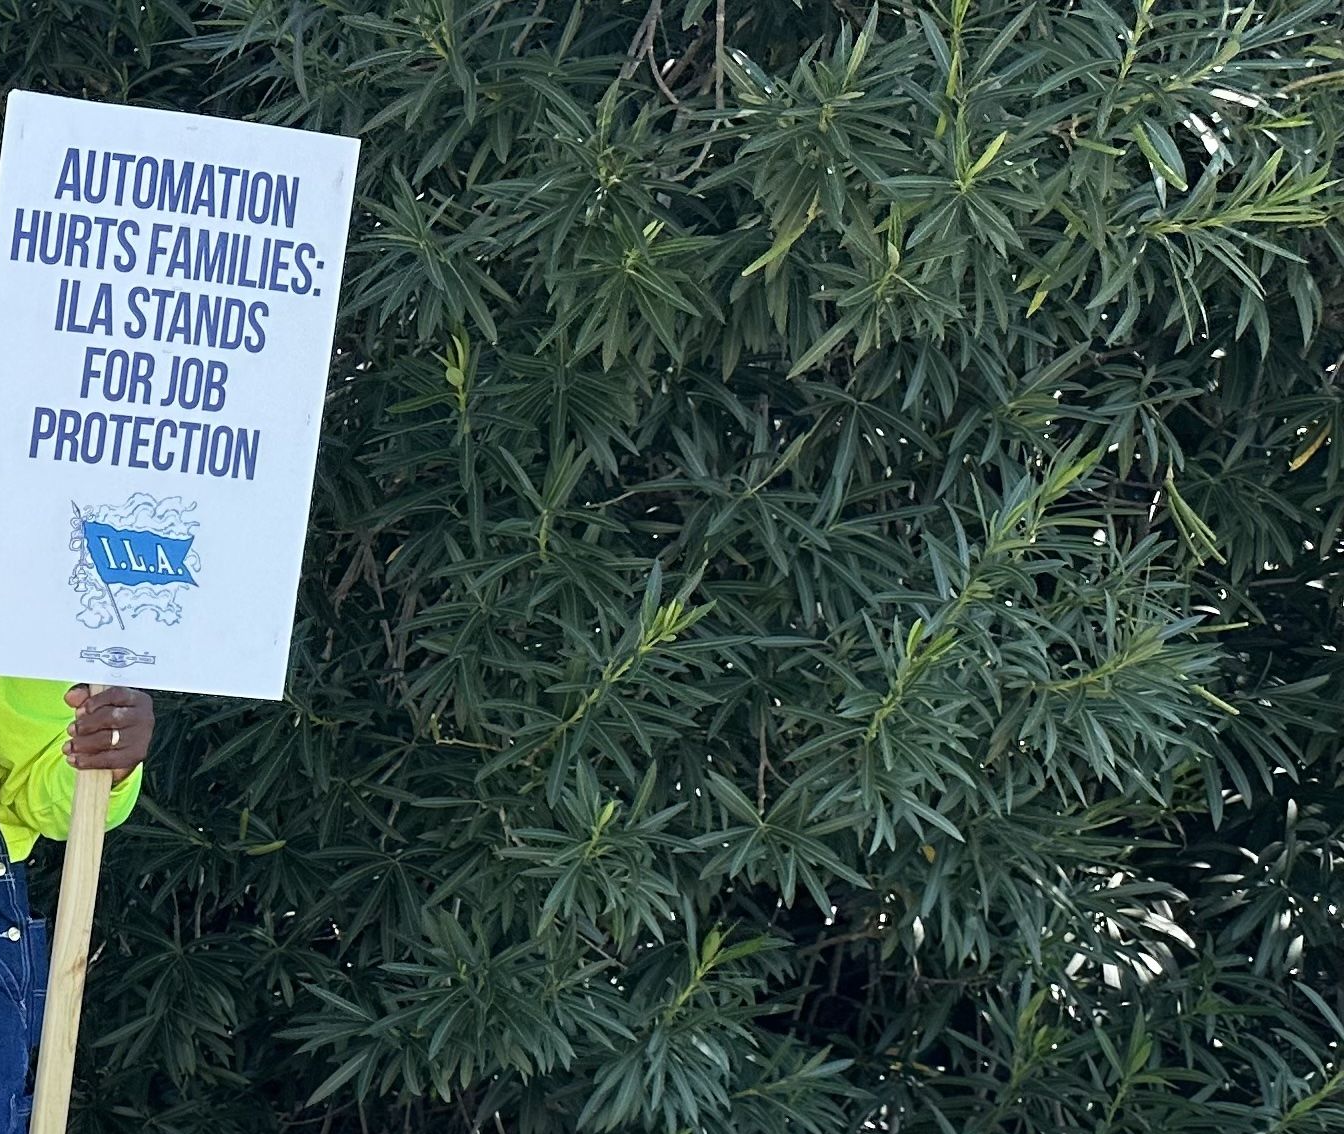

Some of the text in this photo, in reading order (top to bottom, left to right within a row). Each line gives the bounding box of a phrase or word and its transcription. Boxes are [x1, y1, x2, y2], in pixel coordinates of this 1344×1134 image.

[55, 147, 299, 228] AUTOMATION
[10, 208, 325, 297] HURTS FAMILIES:
[55, 279, 270, 353] ILA STANDS
[80, 347, 229, 412] FOR JOB
[29, 407, 260, 481] PROTECTION
[100, 537, 182, 576] I.L.A.
